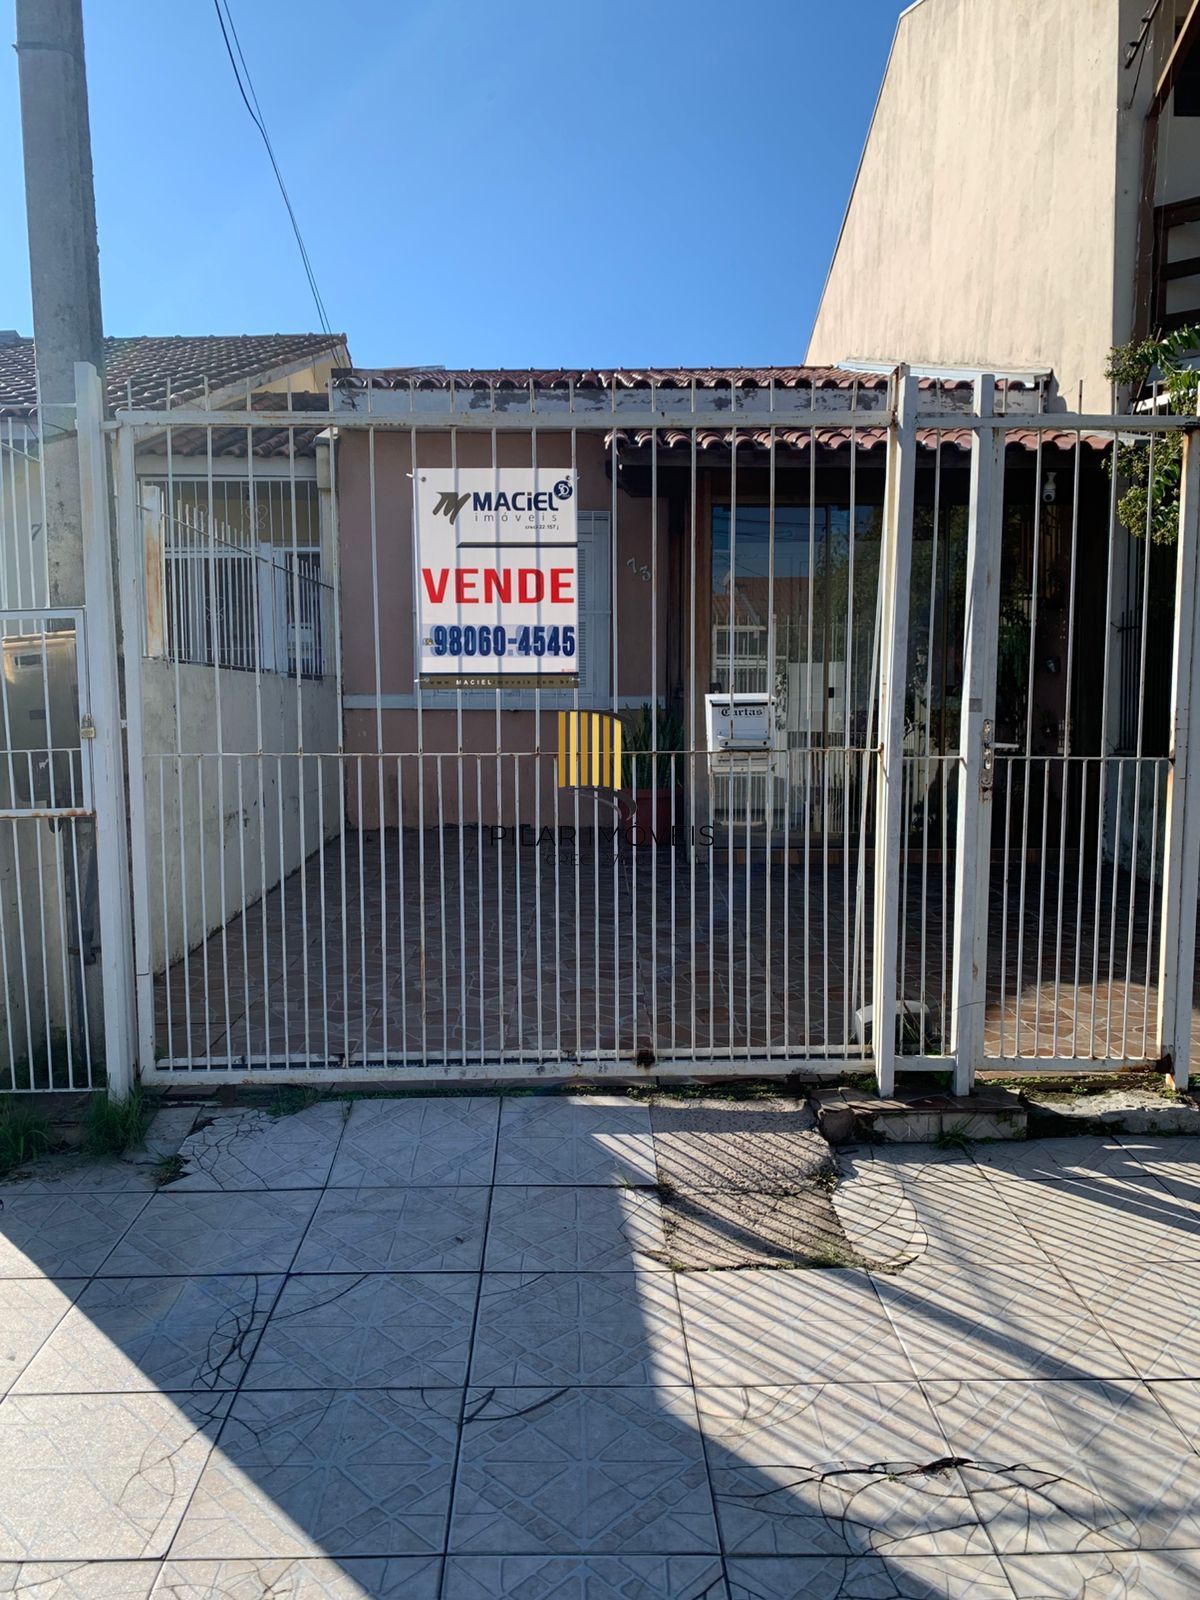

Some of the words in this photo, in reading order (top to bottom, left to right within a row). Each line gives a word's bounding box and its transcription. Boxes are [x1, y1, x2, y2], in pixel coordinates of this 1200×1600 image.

[475, 512, 558, 522] imóveis
[422, 568, 575, 604] VENDE
[433, 625, 575, 656] 98060-4545
